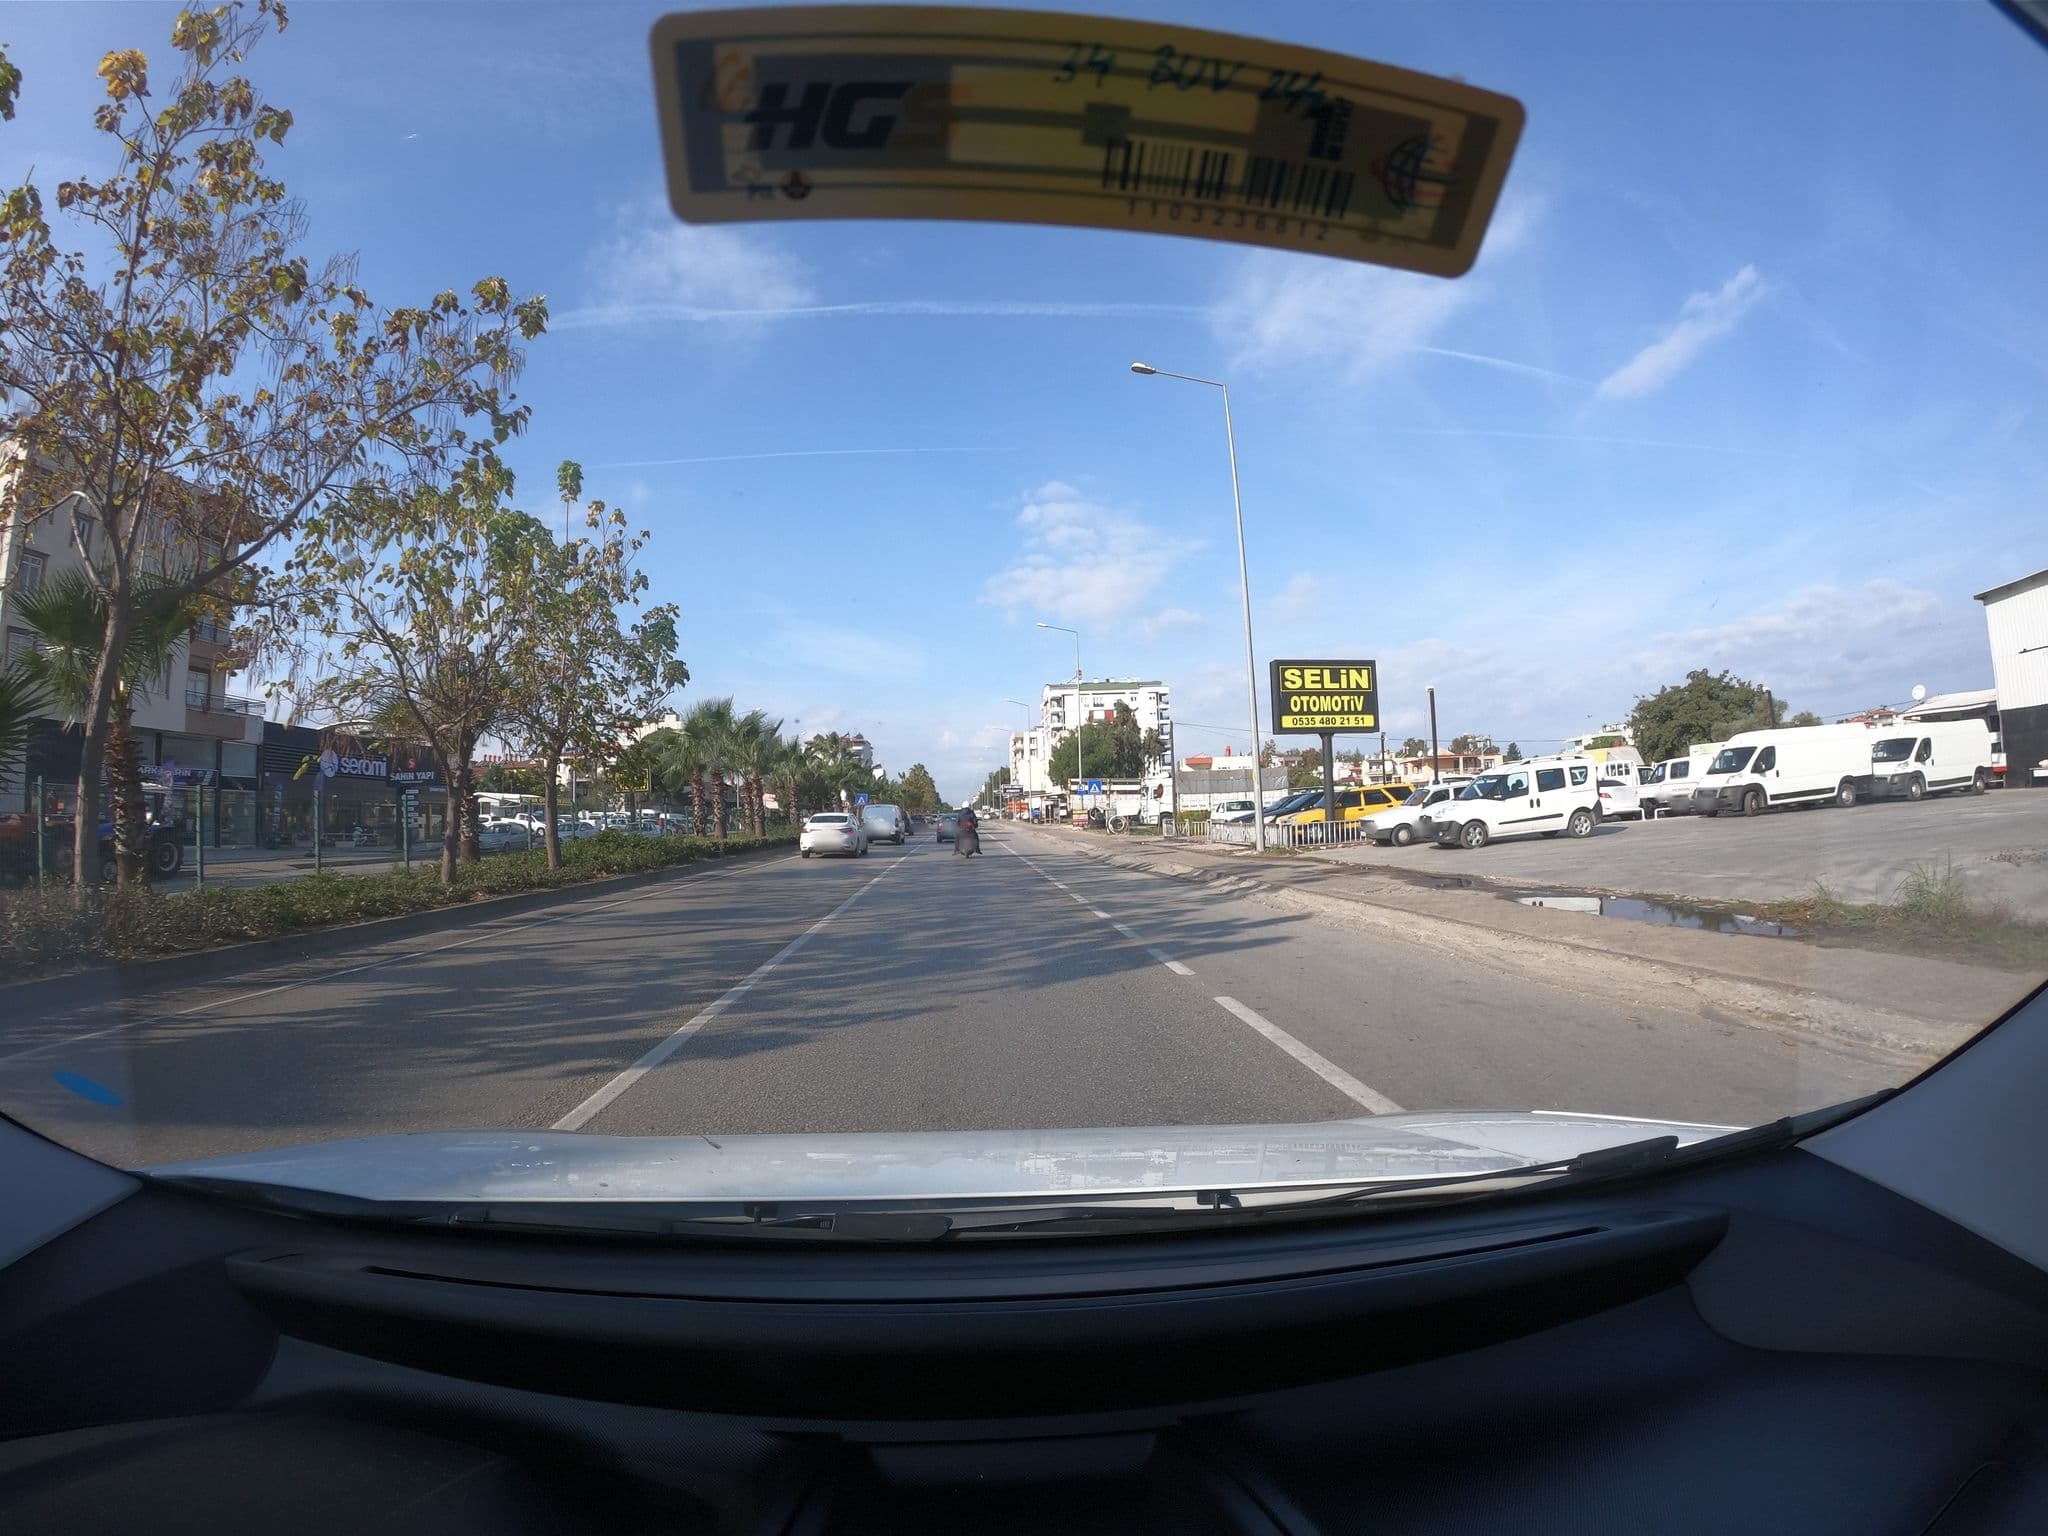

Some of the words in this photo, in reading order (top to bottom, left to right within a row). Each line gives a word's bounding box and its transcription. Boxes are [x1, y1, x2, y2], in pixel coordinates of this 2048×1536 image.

[743, 81, 975, 149] HGS
[1292, 717, 1316, 726] 0535
[1319, 717, 1337, 725] 480
[1340, 717, 1351, 725] 21
[1354, 717, 1365, 725] 51
[340, 757, 387, 777] seromi
